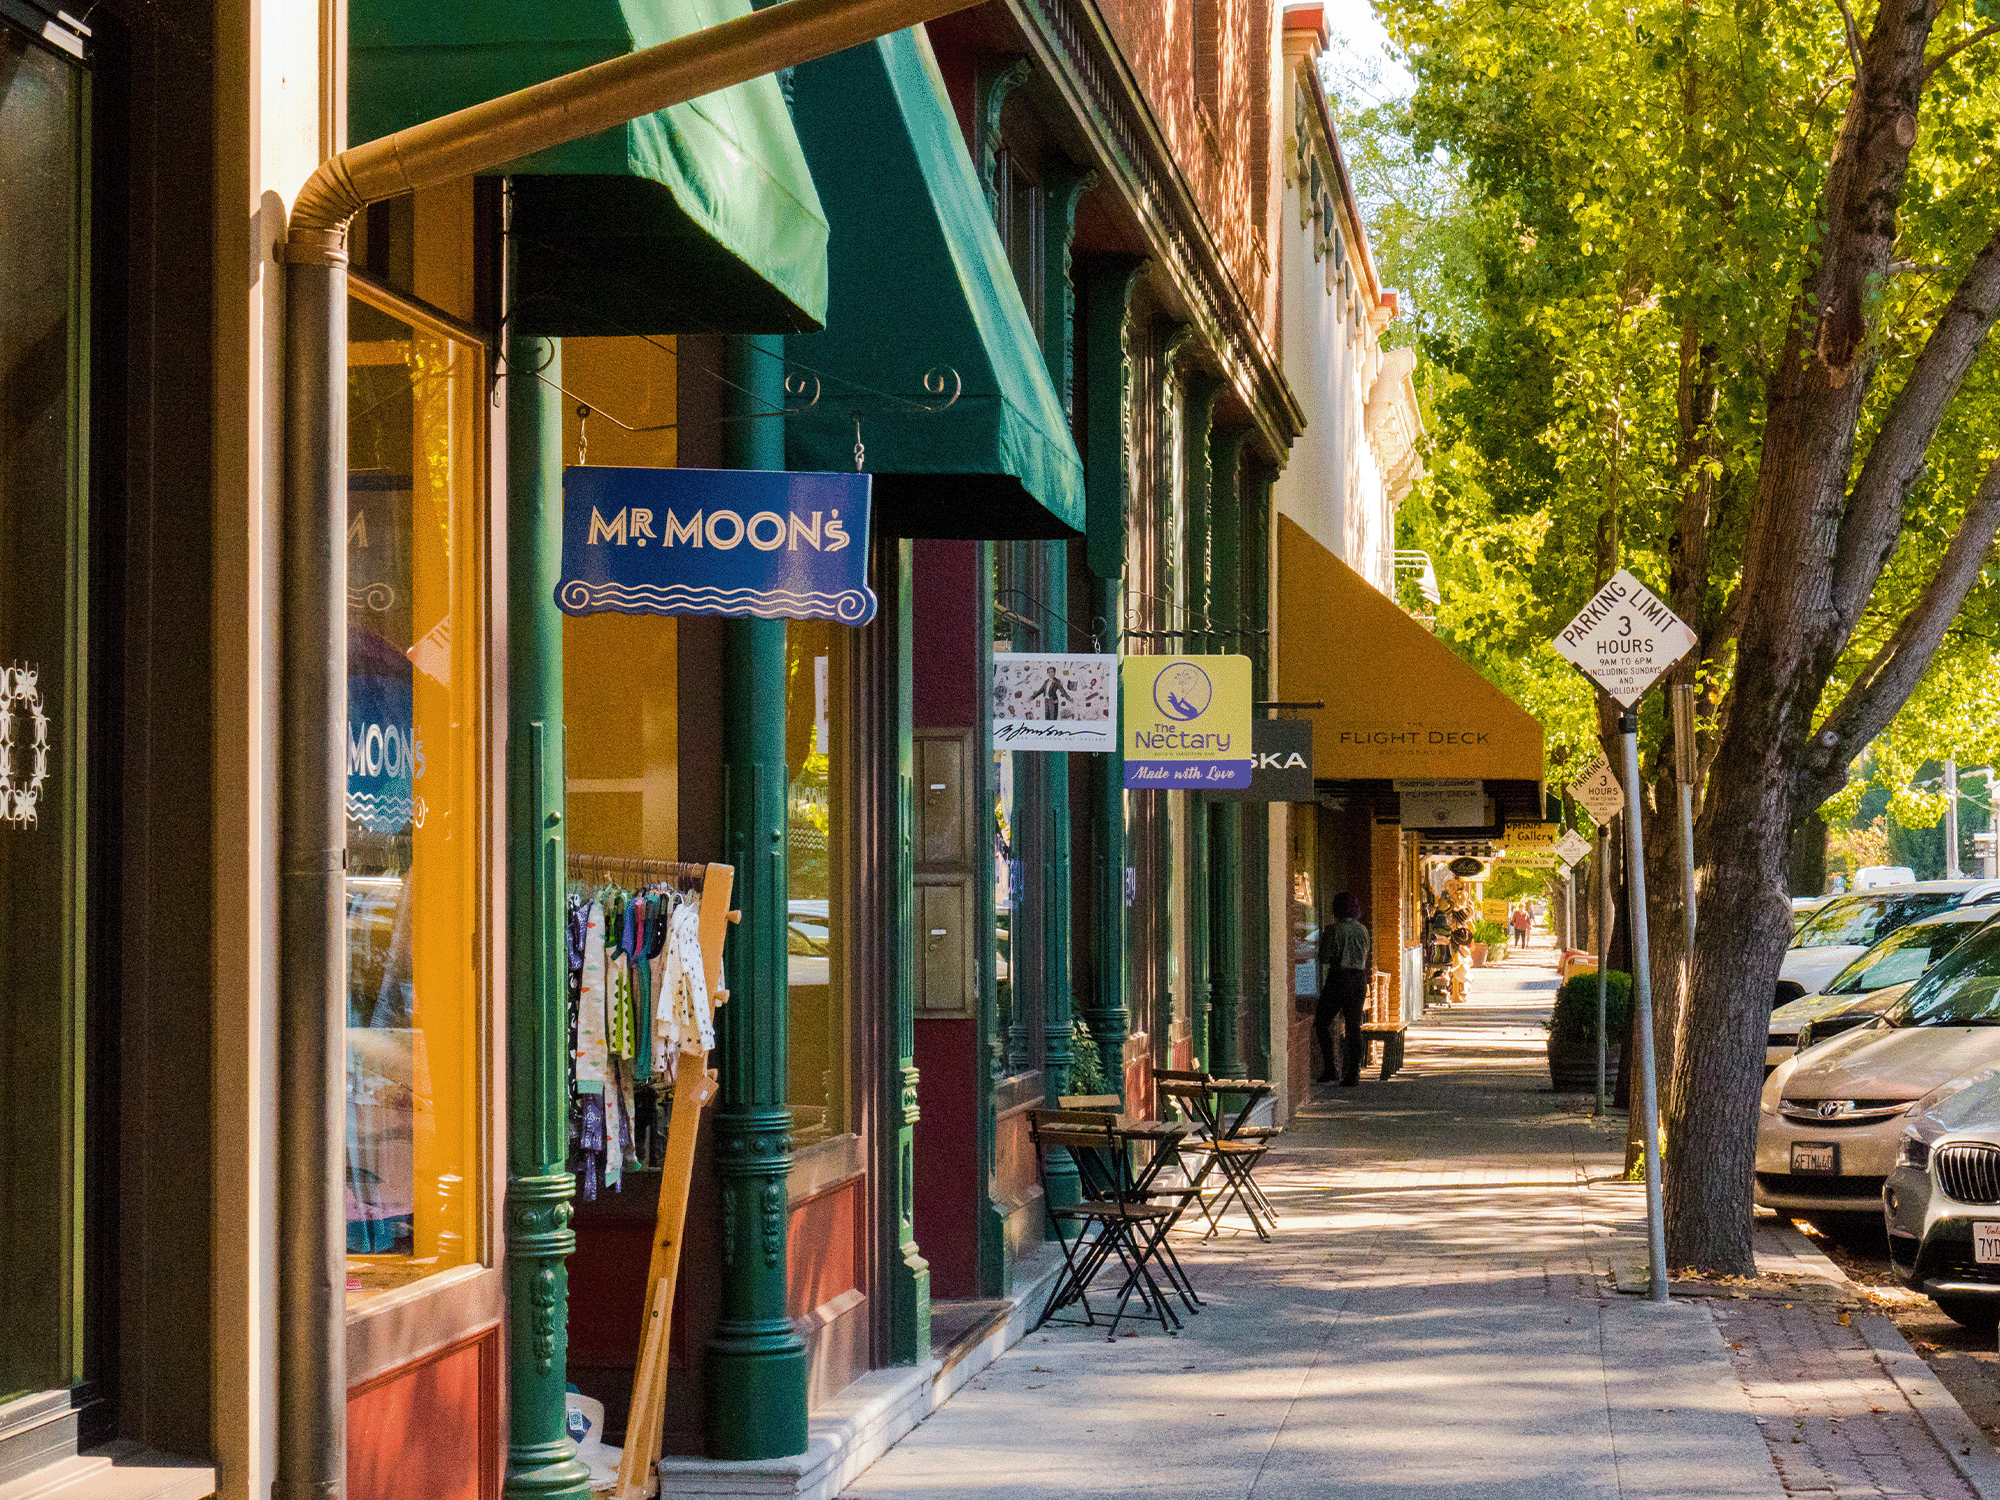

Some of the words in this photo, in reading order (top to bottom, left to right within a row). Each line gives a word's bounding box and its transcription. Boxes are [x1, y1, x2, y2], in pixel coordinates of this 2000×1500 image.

[1562, 581, 1627, 648] PARKING
[1629, 588, 1677, 633] LIMIT
[1617, 615, 1632, 637] 3
[1597, 638, 1654, 655] HOURS
[1599, 658, 1617, 666] 9AM
[1621, 657, 1631, 665] TO
[1634, 656, 1652, 665] 6PM
[1590, 667, 1628, 676] INCLUDING
[1630, 666, 1662, 675] SUNDAYS
[1619, 676, 1634, 684] AND
[1609, 685, 1644, 695] HOLIDAYS
[1154, 723, 1176, 733] The
[1135, 730, 1231, 752] Nectary
[1340, 731, 1420, 744] FLIGHT
[1429, 731, 1490, 744] DECK
[1131, 766, 1171, 780] Made
[1174, 765, 1203, 780] with
[1206, 765, 1236, 781] Love
[1571, 757, 1606, 791] PARKING
[1599, 775, 1608, 787] 3
[1405, 790, 1444, 798] FLIGHT
[1447, 790, 1477, 798] DECK
[1588, 787, 1619, 796] HOURS
[1517, 831, 1553, 844] Gallery
